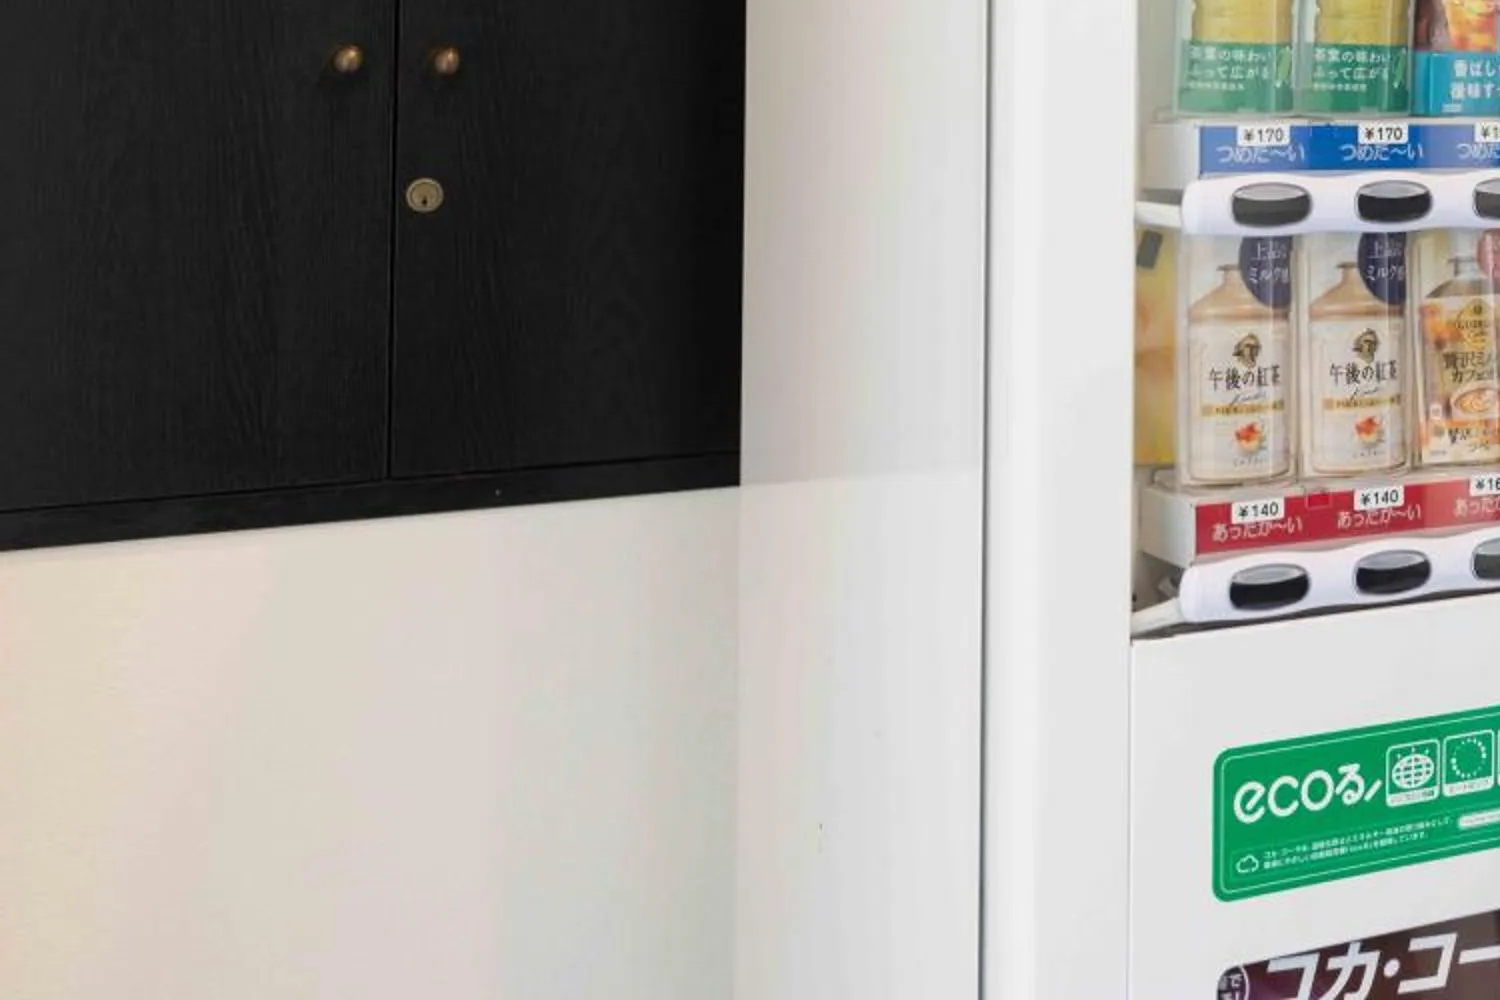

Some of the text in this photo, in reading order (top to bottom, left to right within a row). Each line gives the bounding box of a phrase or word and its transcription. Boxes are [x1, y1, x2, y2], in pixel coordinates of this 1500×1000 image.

[1243, 127, 1285, 142] ¥170
[1364, 126, 1403, 141] ¥170
[1208, 364, 1281, 390] 午後の紅茶
[1329, 359, 1398, 385] 午後の紅茶
[1360, 490, 1399, 506] ¥140
[1238, 502, 1279, 518] ¥140
